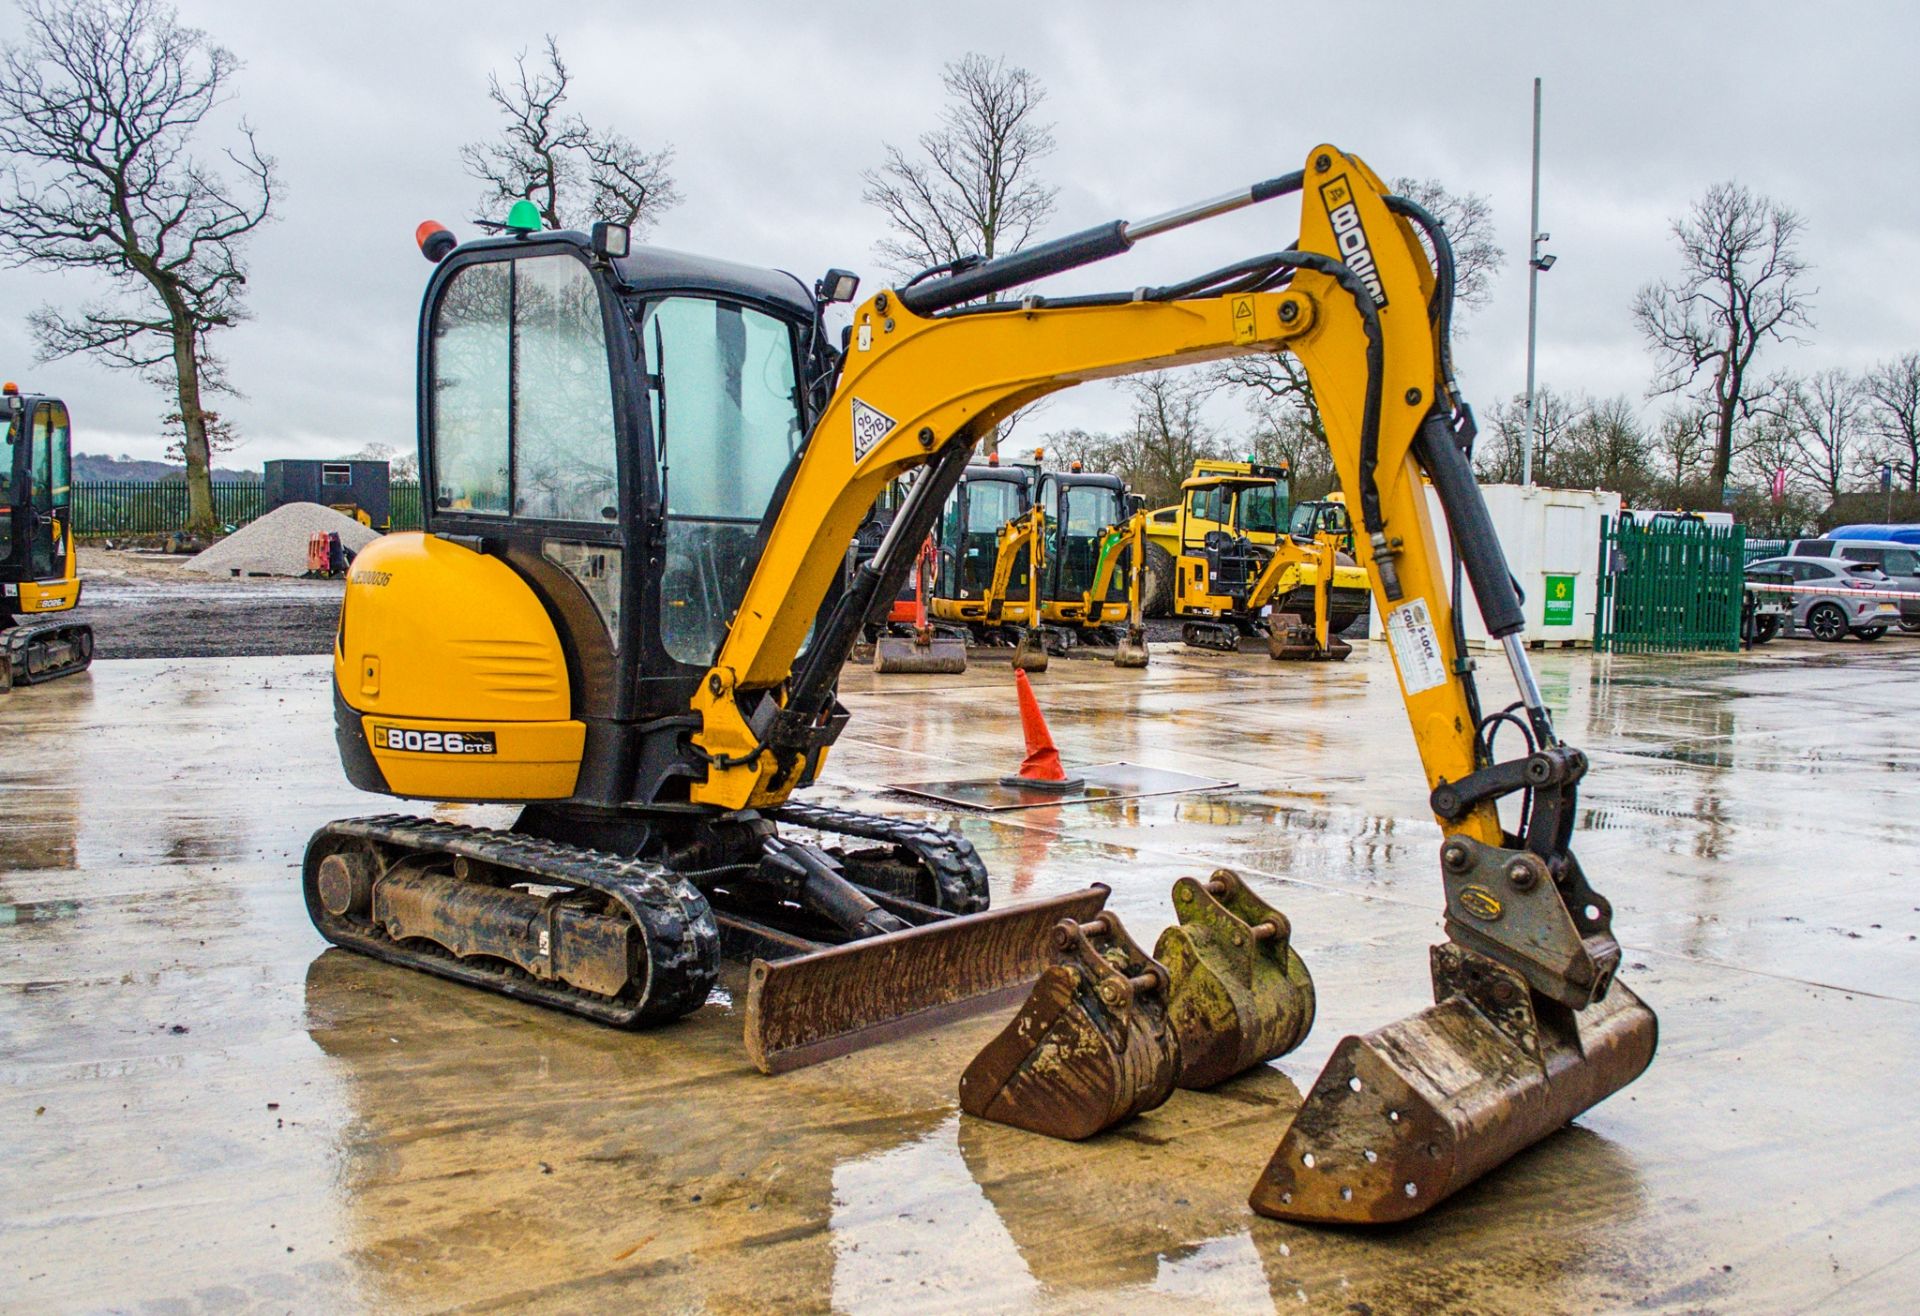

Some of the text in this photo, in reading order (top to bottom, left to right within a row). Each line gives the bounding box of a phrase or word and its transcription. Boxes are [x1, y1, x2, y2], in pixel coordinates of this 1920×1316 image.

[857, 412, 872, 430] 96
[859, 418, 884, 447] AS7B
[388, 728, 464, 752] 8026
[464, 743, 493, 753] CTS
